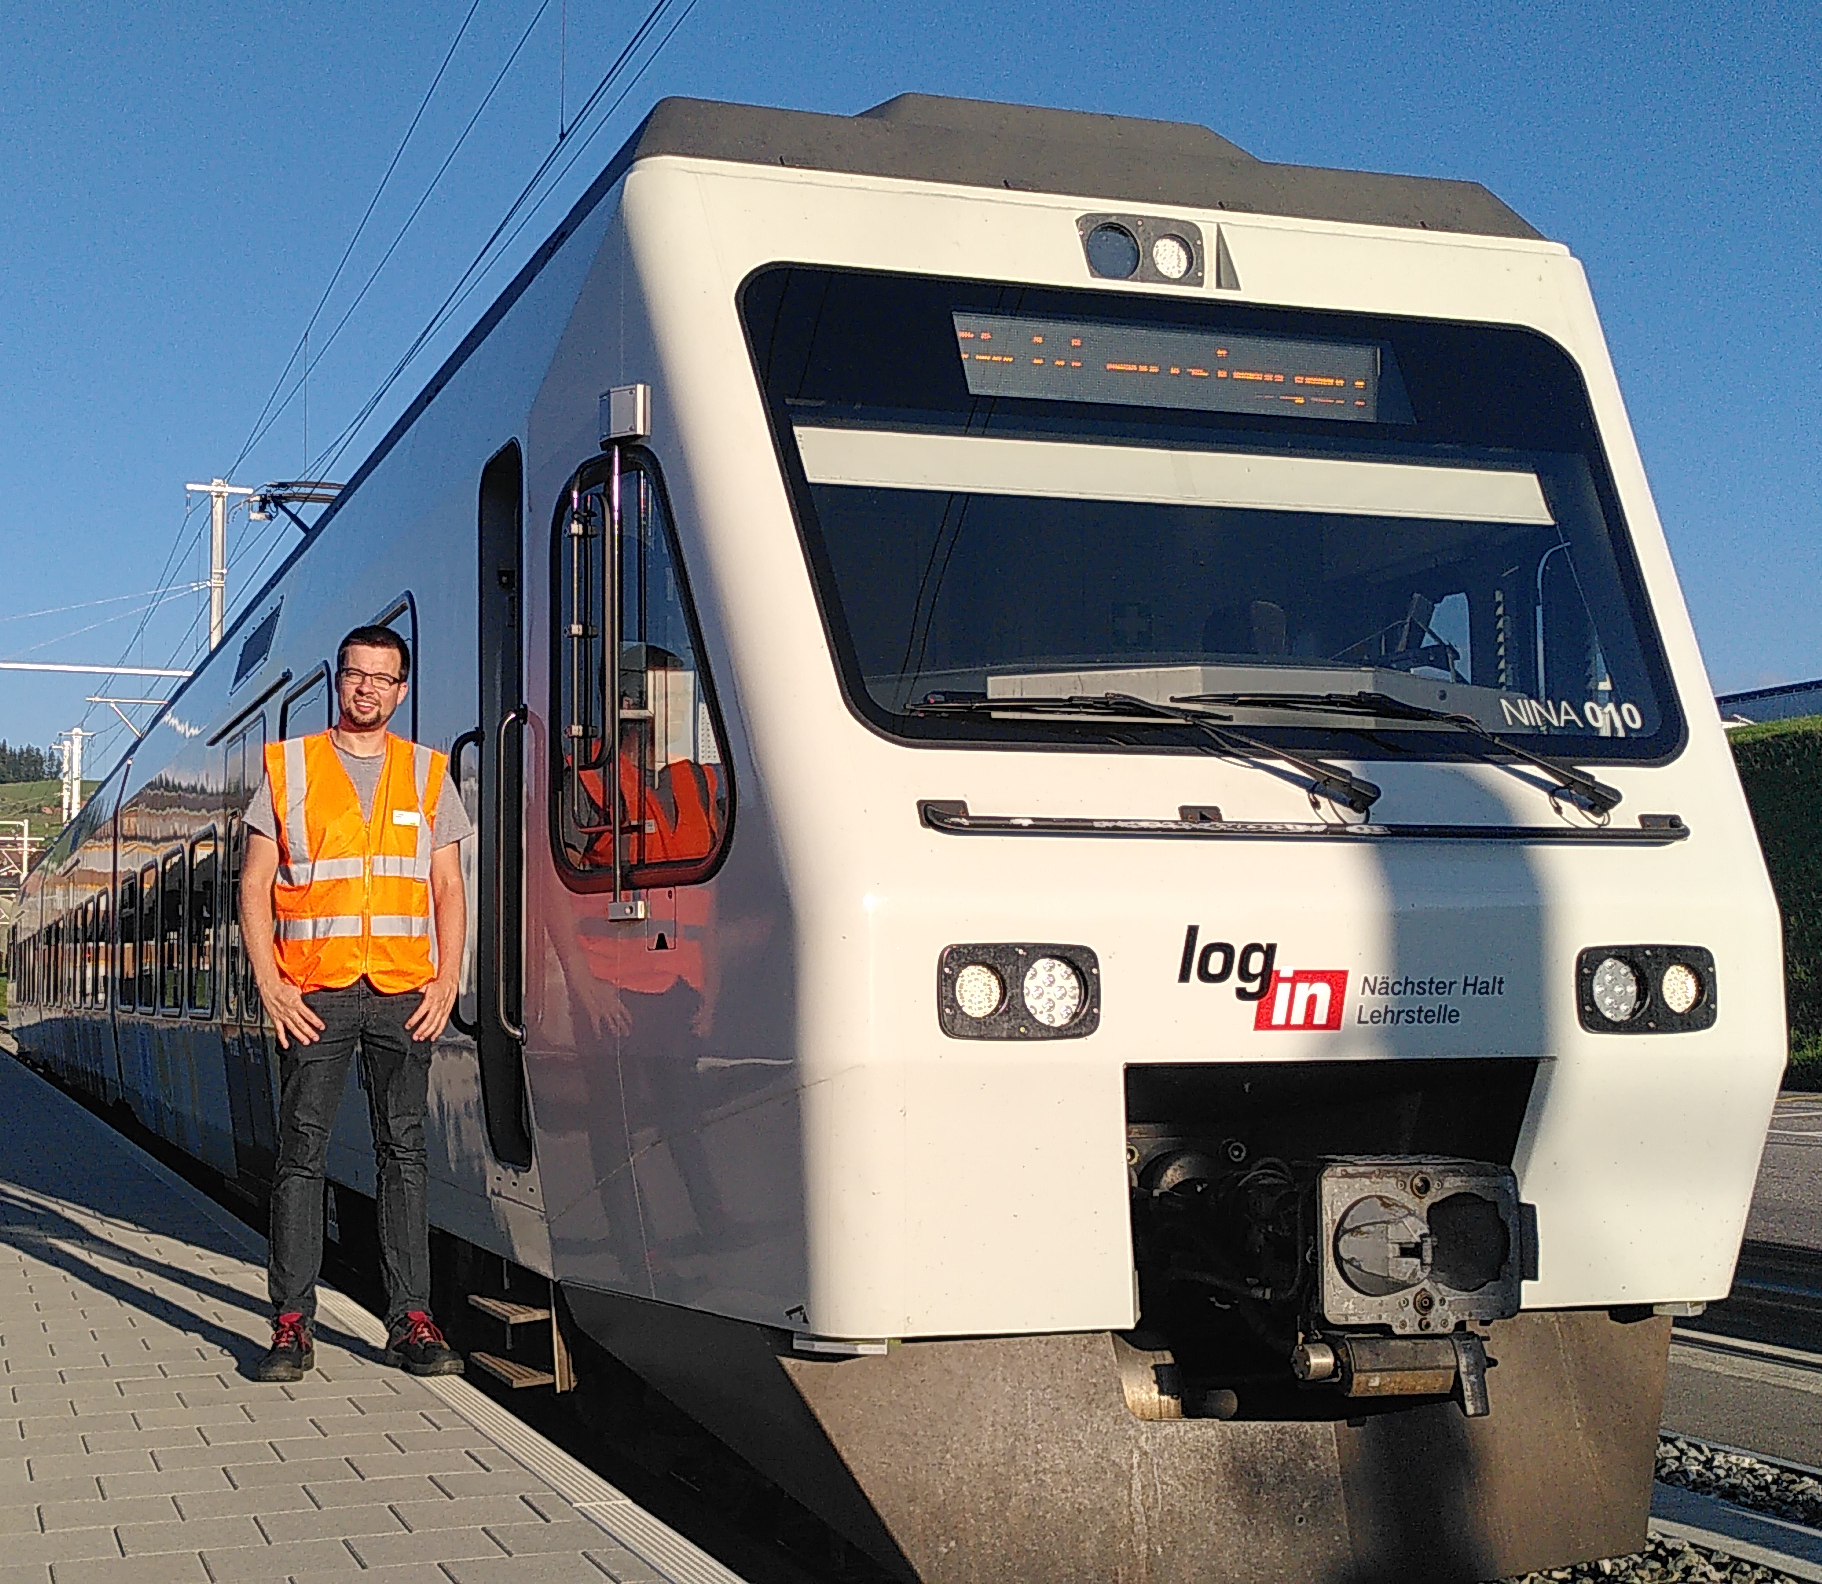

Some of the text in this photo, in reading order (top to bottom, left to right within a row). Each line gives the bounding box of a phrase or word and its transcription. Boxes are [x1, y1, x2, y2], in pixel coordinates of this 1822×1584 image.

[1499, 698, 1642, 729] NINA 010
[1178, 924, 1277, 1000] log
[1271, 966, 1332, 1025] in
[1360, 975, 1505, 996] Nächster Halt
[1356, 1004, 1460, 1025] Lehrstelle
